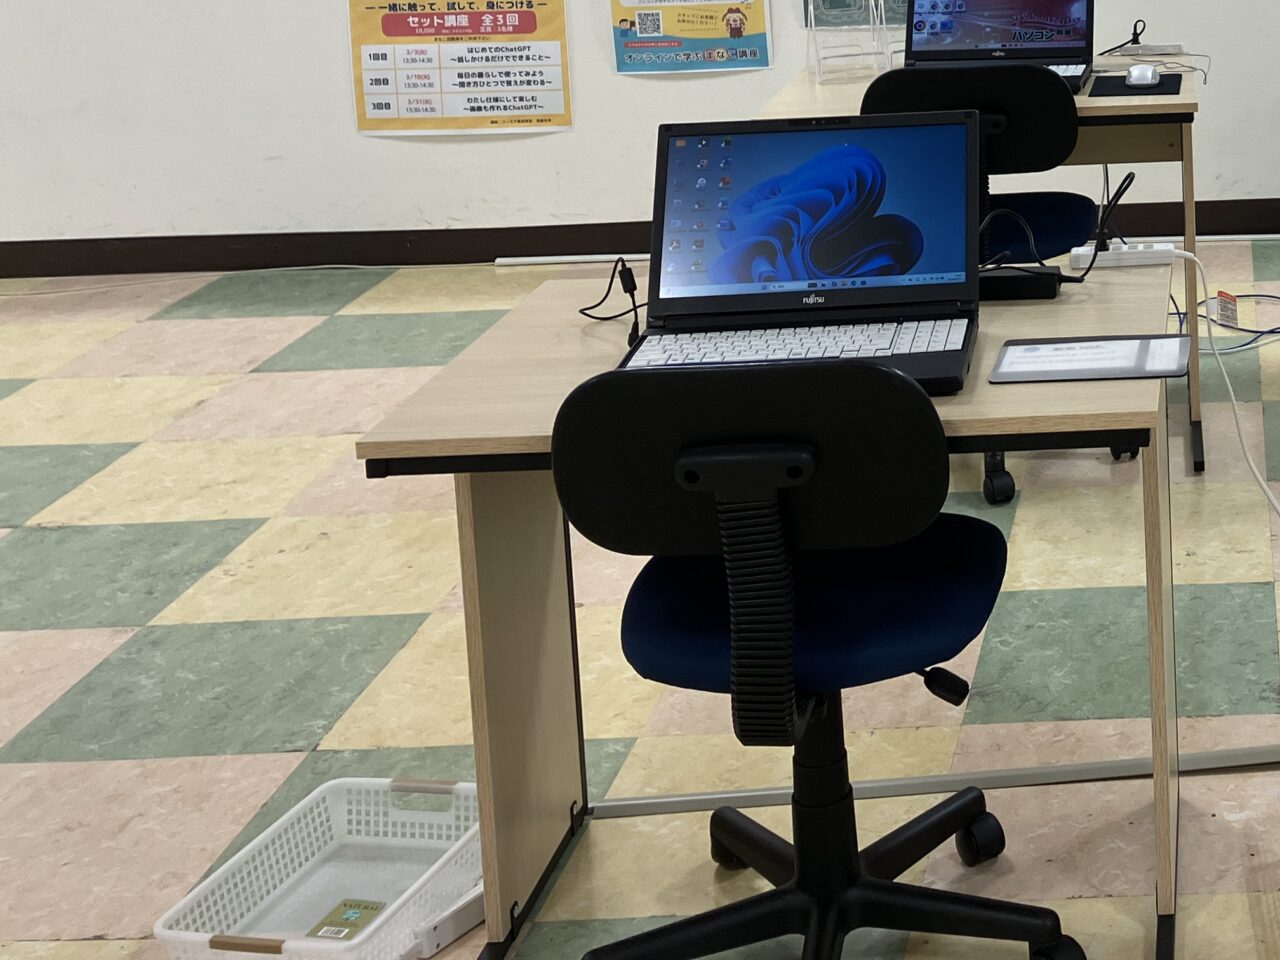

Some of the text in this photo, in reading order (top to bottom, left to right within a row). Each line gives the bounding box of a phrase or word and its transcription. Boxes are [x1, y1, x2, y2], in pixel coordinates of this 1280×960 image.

[407, 14, 469, 27] セット講座
[802, 294, 825, 305] FUJITSU
